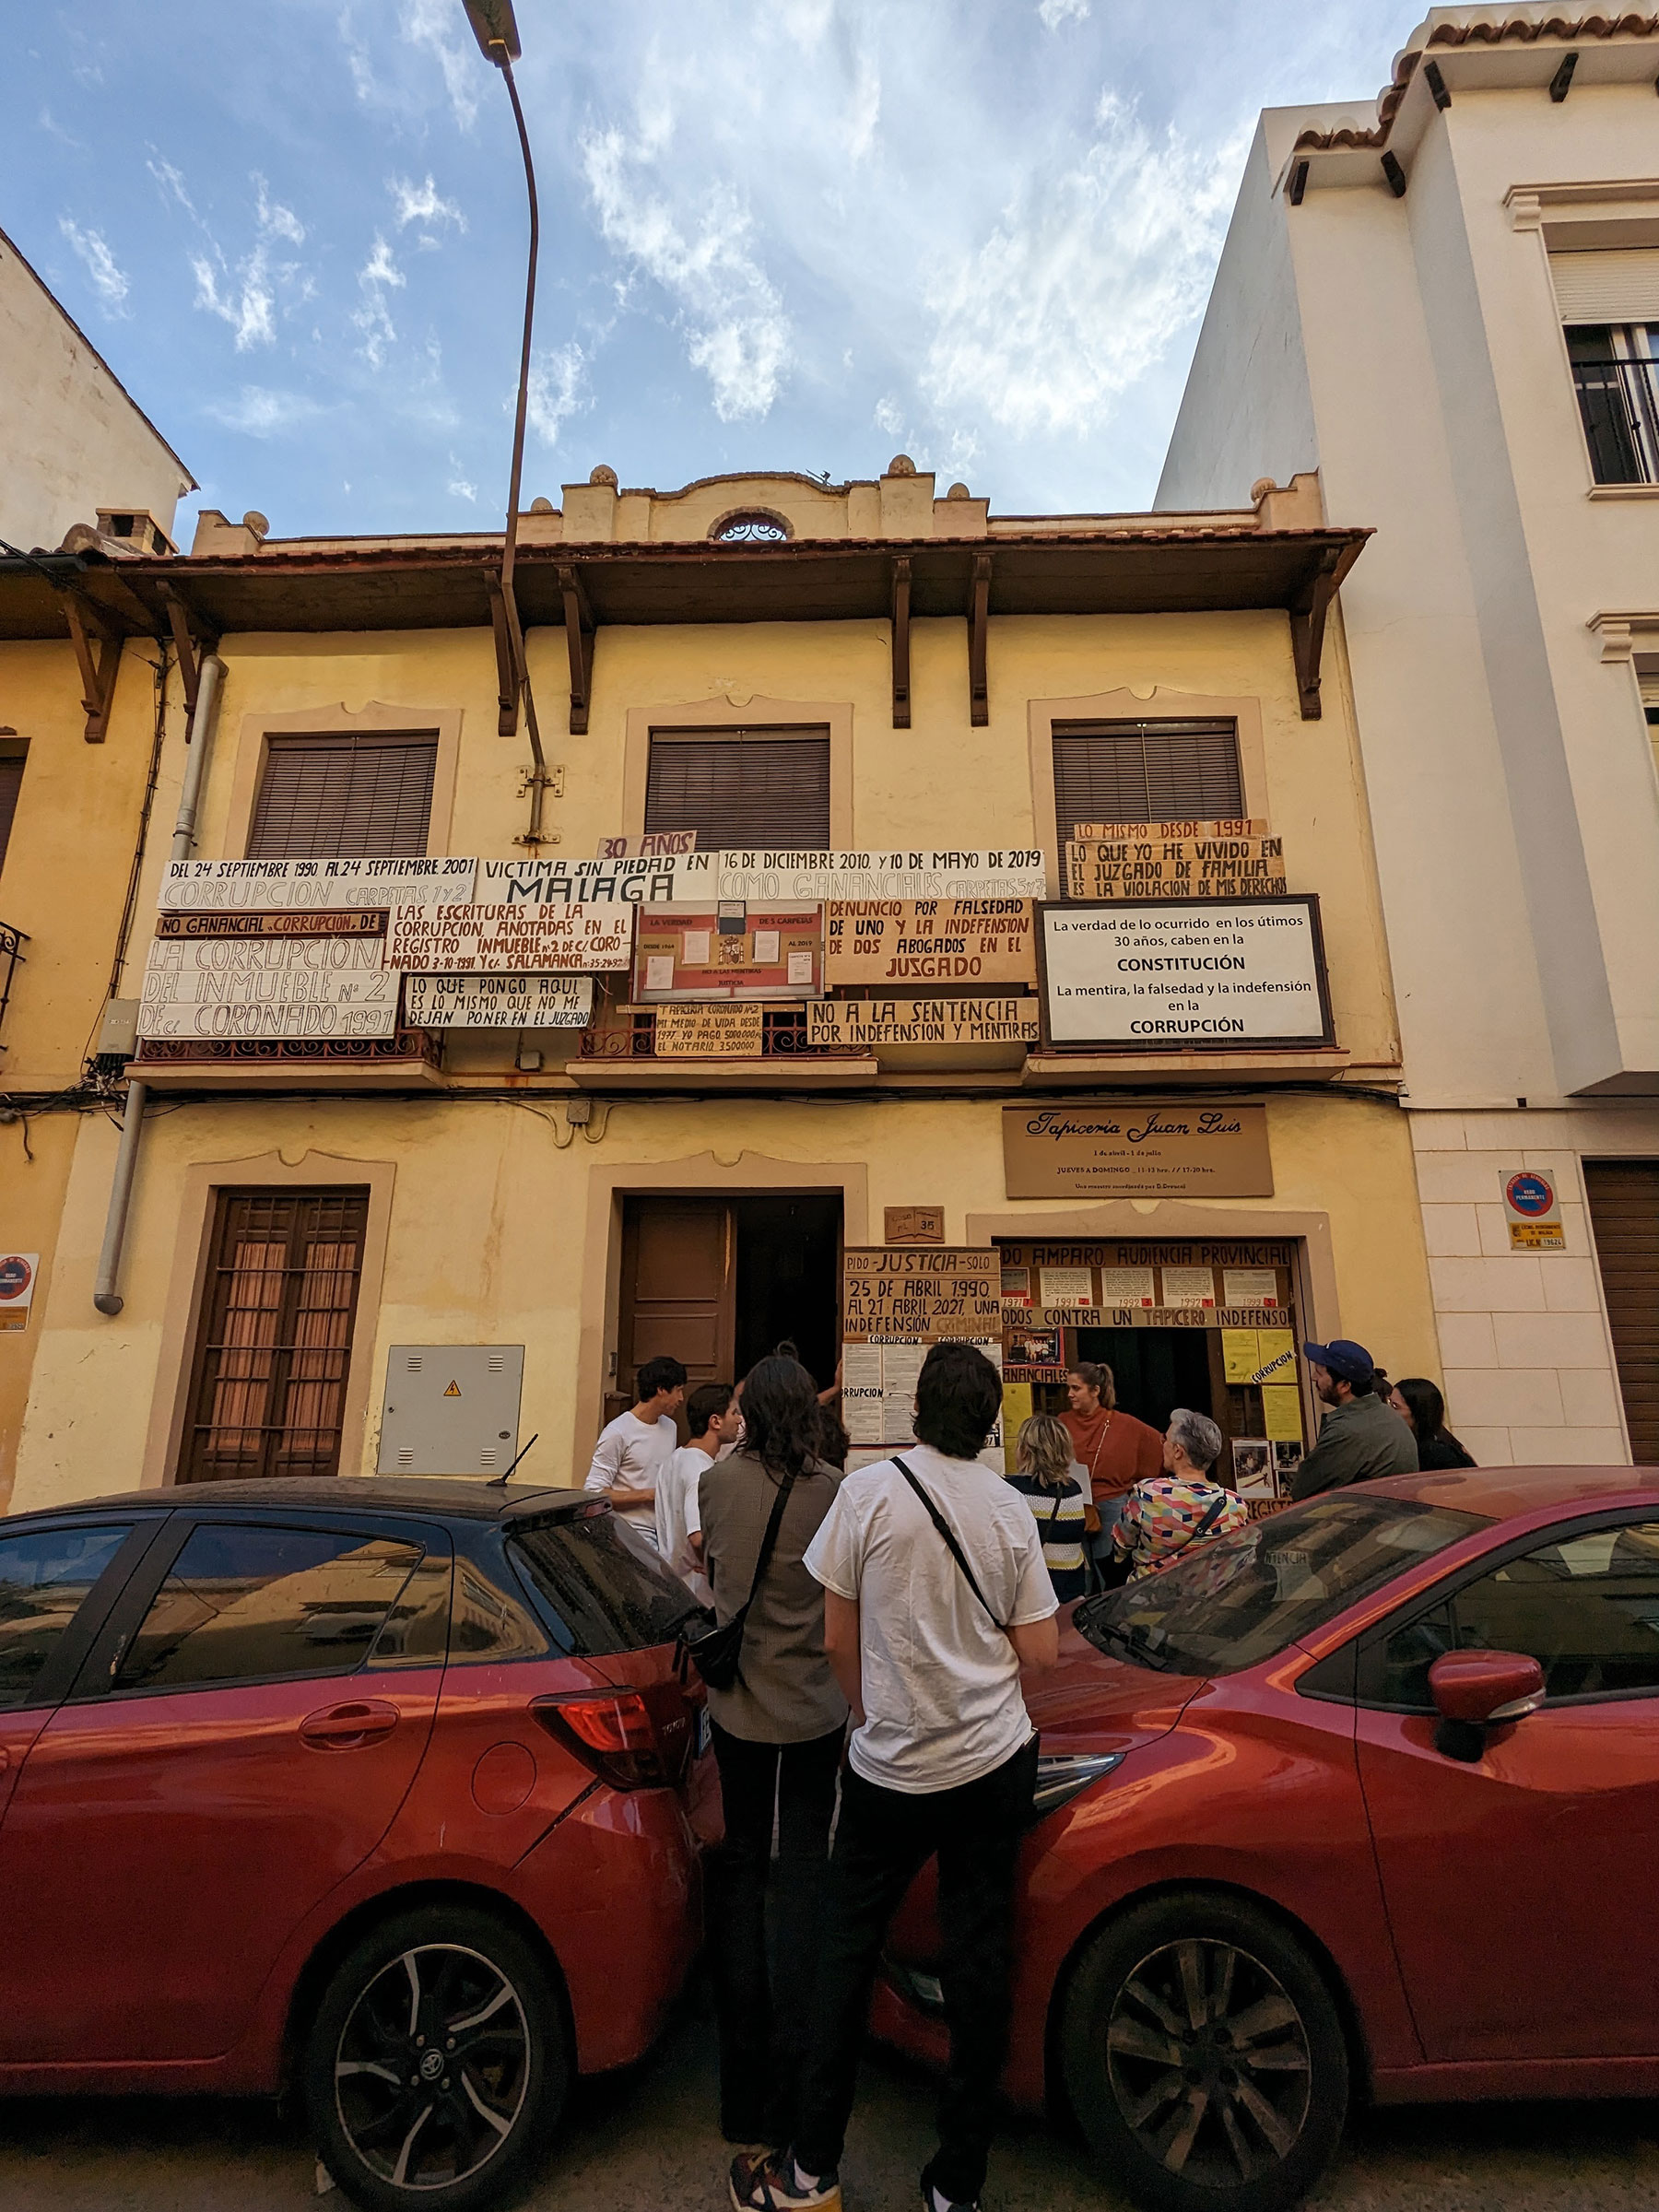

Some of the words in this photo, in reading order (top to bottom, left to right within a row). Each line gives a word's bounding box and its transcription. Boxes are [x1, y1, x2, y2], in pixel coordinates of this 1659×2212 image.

[1102, 824, 1147, 838] MISMO
[1160, 822, 1199, 838] DESDE
[640, 831, 694, 857] AÑOS
[1071, 845, 1087, 863] LO
[1097, 844, 1128, 862] QUE
[1135, 844, 1152, 861] YO
[1163, 843, 1183, 860] HE
[1194, 842, 1250, 859] VIVIDO
[171, 863, 189, 877] DEL
[195, 863, 212, 877] 24
[217, 862, 288, 877] SEPTIEMBRE
[442, 859, 475, 876] 2001
[486, 861, 568, 878] VICTIMA
[575, 861, 604, 877] SIN
[614, 856, 676, 876] PIEDAD
[686, 854, 709, 871] EN
[724, 853, 738, 868] 16
[741, 853, 756, 869] DE
[763, 852, 835, 870] DICIEMBRE
[909, 853, 924, 869] DE
[933, 852, 980, 869] MAYO
[988, 851, 1003, 868] DE
[1094, 861, 1163, 881] JUZGADO
[1176, 861, 1192, 878] DE
[1202, 859, 1269, 877] FAMILIA
[164, 881, 335, 907] CORRUPCION
[506, 874, 675, 904] MALAGA
[719, 872, 782, 900] COMO
[793, 871, 943, 900] GANANCIALES
[946, 878, 1017, 900] CARPETAS
[1124, 879, 1191, 897] VIOLACION
[1217, 877, 1236, 895] MIS
[396, 904, 425, 921] LAS
[437, 903, 527, 921] ESCRITURAS
[538, 903, 556, 920] DE
[565, 903, 583, 920] LA
[830, 901, 902, 917] DENUNCIO
[914, 900, 938, 916] POR
[953, 900, 1024, 916] FALSEDAD
[161, 918, 180, 934] NO
[186, 916, 264, 934] GANANCIAL
[359, 914, 376, 930] DE
[496, 920, 574, 937] ANOTADAS
[584, 920, 602, 935] EN
[614, 918, 627, 935] EL
[776, 916, 813, 925] CARPETAS
[830, 920, 845, 936] DE
[855, 920, 885, 935] UNO
[915, 919, 934, 935] LA
[944, 917, 1030, 935] INDEFENSION
[1053, 921, 1069, 932] La
[1071, 919, 1117, 932] verdad
[1119, 919, 1137, 931] de
[1138, 918, 1151, 931] lo
[1154, 918, 1210, 931] ocurrido
[1216, 920, 1233, 929] en
[1235, 916, 1255, 929] los
[393, 936, 460, 954] REGISTRO
[477, 936, 541, 954] INMUEBLE
[830, 939, 843, 955] DE
[853, 938, 882, 955] DOS
[896, 938, 967, 954] ABOGADOS
[980, 936, 998, 954] EN
[1007, 936, 1022, 953] EL
[1113, 936, 1130, 947] 30
[1171, 934, 1211, 947] caben
[1213, 936, 1230, 946] en
[1232, 933, 1244, 946] la
[149, 940, 185, 971] LA
[195, 938, 380, 971] CORRUPCION
[507, 953, 583, 970] SALAMANCA
[1117, 953, 1246, 972] CONSTITUCIÓN
[144, 971, 179, 1003] DEL
[194, 971, 334, 1003] INMUEBLE
[412, 978, 427, 994] LO
[437, 978, 465, 994] QUE
[479, 978, 527, 994] PONGO
[1057, 984, 1073, 997] La
[1075, 984, 1131, 998] mentira,
[1134, 982, 1146, 995] la
[1148, 982, 1205, 995] falsedad
[1218, 982, 1230, 994] la
[1233, 980, 1312, 994] indefensión
[411, 995, 423, 1010] ES
[431, 995, 445, 1010] LO
[454, 995, 498, 1010] MISMO
[507, 995, 532, 1010] QUE
[538, 995, 555, 1010] NO
[564, 995, 581, 1010] ME
[708, 1004, 743, 1015] CORONADO
[1168, 1001, 1184, 1012] en
[1187, 999, 1200, 1011] la
[194, 1005, 337, 1035] CORONADO
[343, 1009, 394, 1035] 1991
[409, 1010, 454, 1025] DEJAN
[466, 1011, 508, 1025] PONER
[534, 1011, 546, 1026] EL
[549, 1010, 589, 1026] JUZGADO
[813, 1003, 835, 1024] NO
[872, 1003, 896, 1023] LA
[911, 1001, 1018, 1023] SENTENCIA
[740, 1017, 760, 1028] DESDE
[811, 1024, 841, 1042] POR
[850, 1023, 946, 1042] INDEFENSION
[971, 1021, 1039, 1041] MENTIRAS
[1130, 1017, 1245, 1034] CORRUPCIÓN
[1025, 1112, 1121, 1142] Tapicería
[1126, 1112, 1190, 1143] Juan
[1196, 1112, 1242, 1135] Luis
[921, 1220, 935, 1230] 35
[847, 1257, 869, 1270] PIDO
[1117, 1246, 1192, 1265] AUDIENCIA
[1202, 1246, 1288, 1265] PROVINCIAL
[850, 1281, 871, 1297] 25
[877, 1281, 894, 1298] DE
[904, 1280, 942, 1298] ABRIL
[848, 1299, 864, 1315] AL
[892, 1299, 927, 1316] ABRIL
[974, 1300, 1000, 1315] UNA
[1055, 1298, 1077, 1308] 1991
[1119, 1298, 1140, 1308] 1992
[1181, 1298, 1201, 1307] 1992
[1242, 1298, 1262, 1307] 1999
[845, 1314, 931, 1333] INDEFENSIÓN
[1002, 1309, 1033, 1325] ODOS
[1044, 1309, 1100, 1325] CONTRA
[1112, 1309, 1133, 1325] UN
[1143, 1309, 1206, 1326] TAPICERO
[870, 1335, 919, 1346] CORRUPCION
[1003, 1368, 1069, 1383] ANANCIALES
[1251, 1349, 1294, 1384] CORRUPCION
[841, 1388, 884, 1398] ORRUPCION
